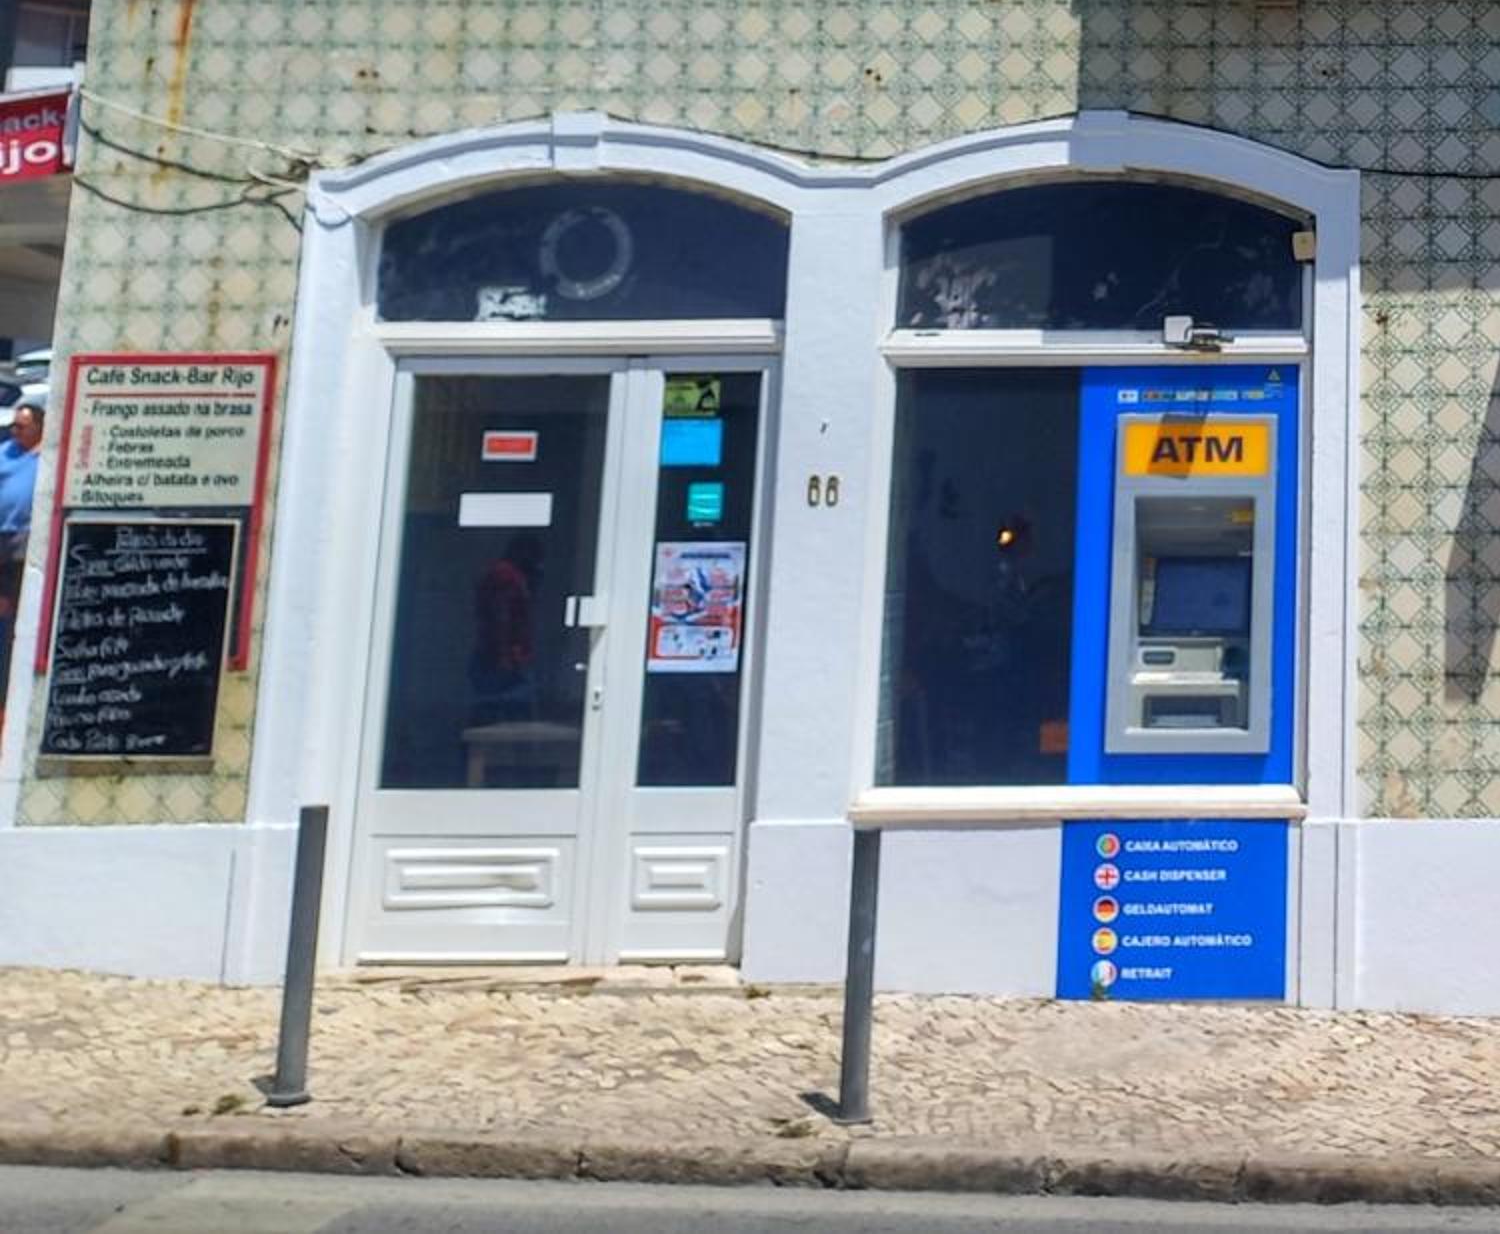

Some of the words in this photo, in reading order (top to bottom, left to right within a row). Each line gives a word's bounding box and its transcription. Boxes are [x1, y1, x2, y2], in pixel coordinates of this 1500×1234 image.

[221, 366, 255, 388] Rijo
[91, 400, 139, 419] Frango
[143, 400, 191, 415] assado
[194, 403, 211, 415] na
[214, 400, 253, 416] brasa
[1151, 435, 1244, 463] ATM
[153, 473, 197, 486] batata
[213, 475, 239, 486] ovo
[807, 475, 840, 507] 66
[1124, 839, 1162, 852] CAIXA
[1123, 869, 1158, 881] CASH
[1159, 869, 1227, 881] DISPENSER
[1122, 903, 1214, 915] GELDAUTOMAT
[1121, 934, 1172, 947] CAJERO
[1120, 967, 1173, 980] RETRAIT
